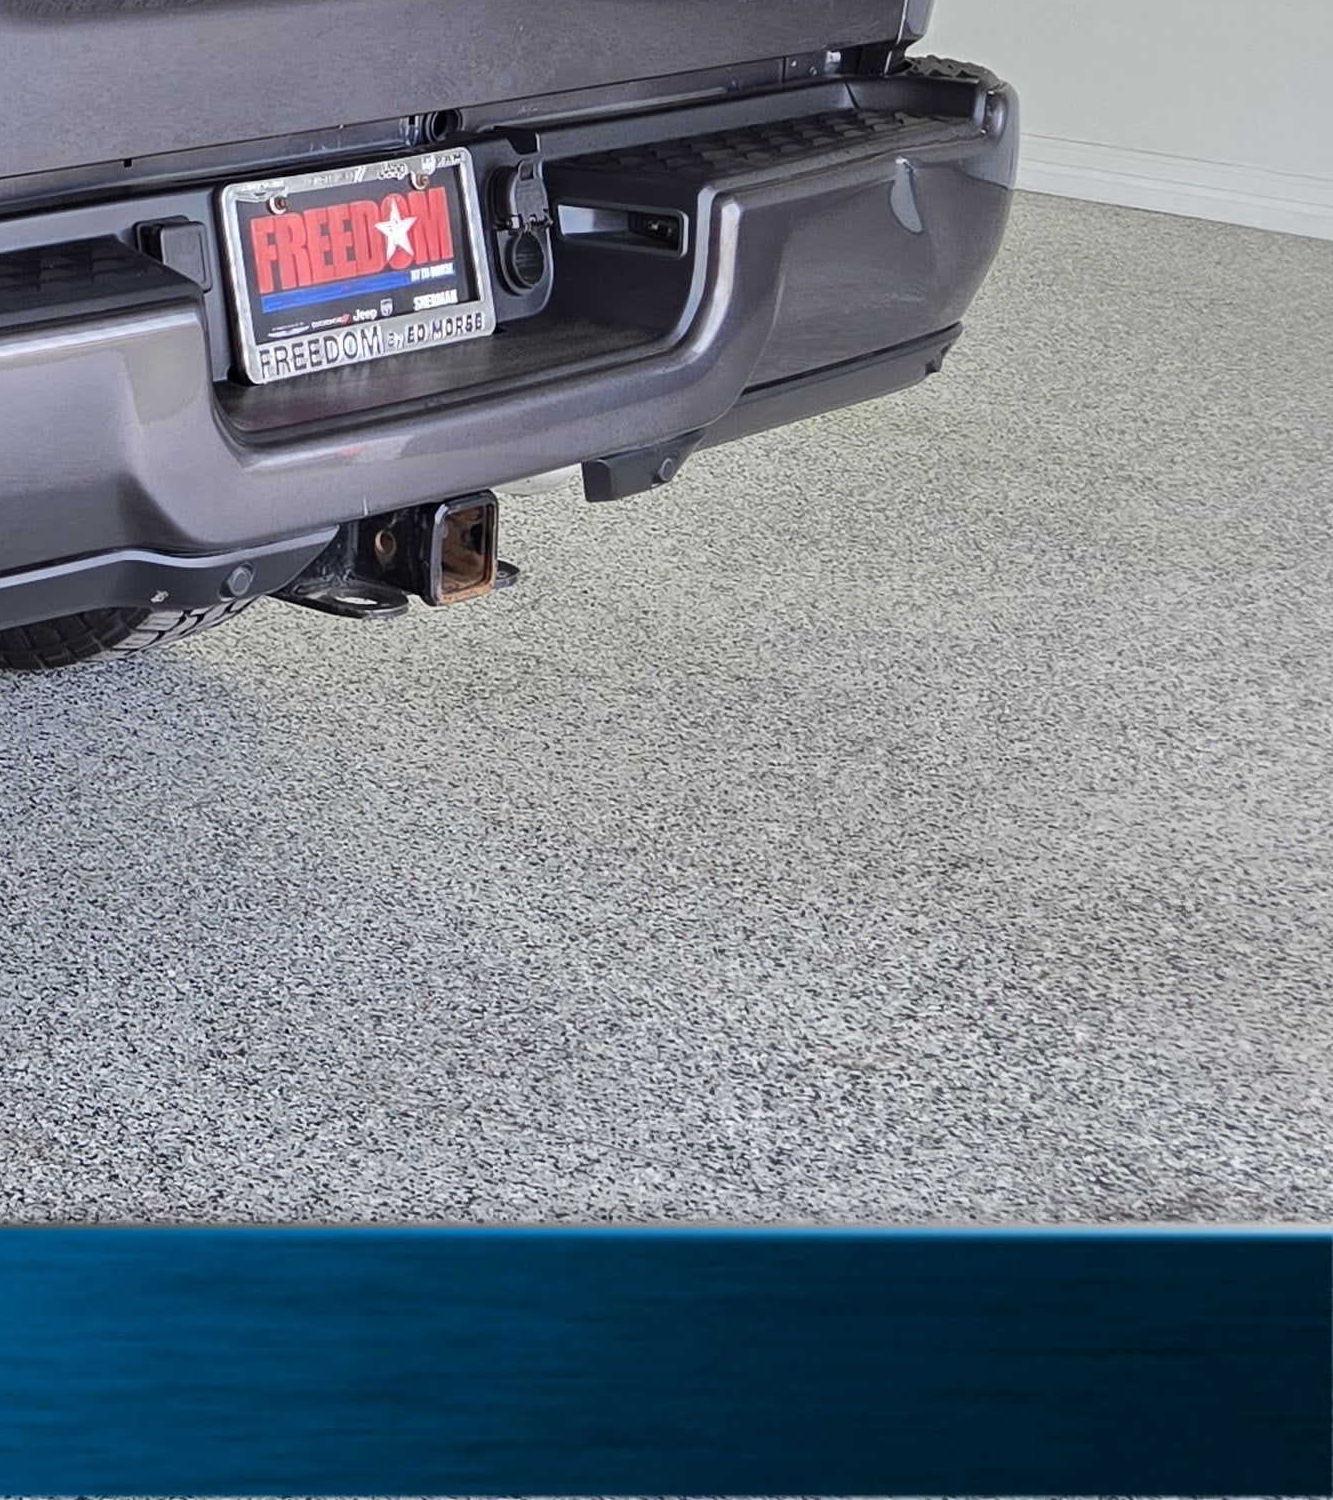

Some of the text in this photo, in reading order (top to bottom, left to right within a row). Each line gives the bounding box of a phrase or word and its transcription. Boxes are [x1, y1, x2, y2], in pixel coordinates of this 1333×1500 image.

[250, 186, 454, 294] FREEDOM
[260, 323, 383, 380] FREEDOM
[407, 324, 427, 344] ED
[432, 311, 485, 340] MORSE
[353, 308, 378, 322] Jeep
